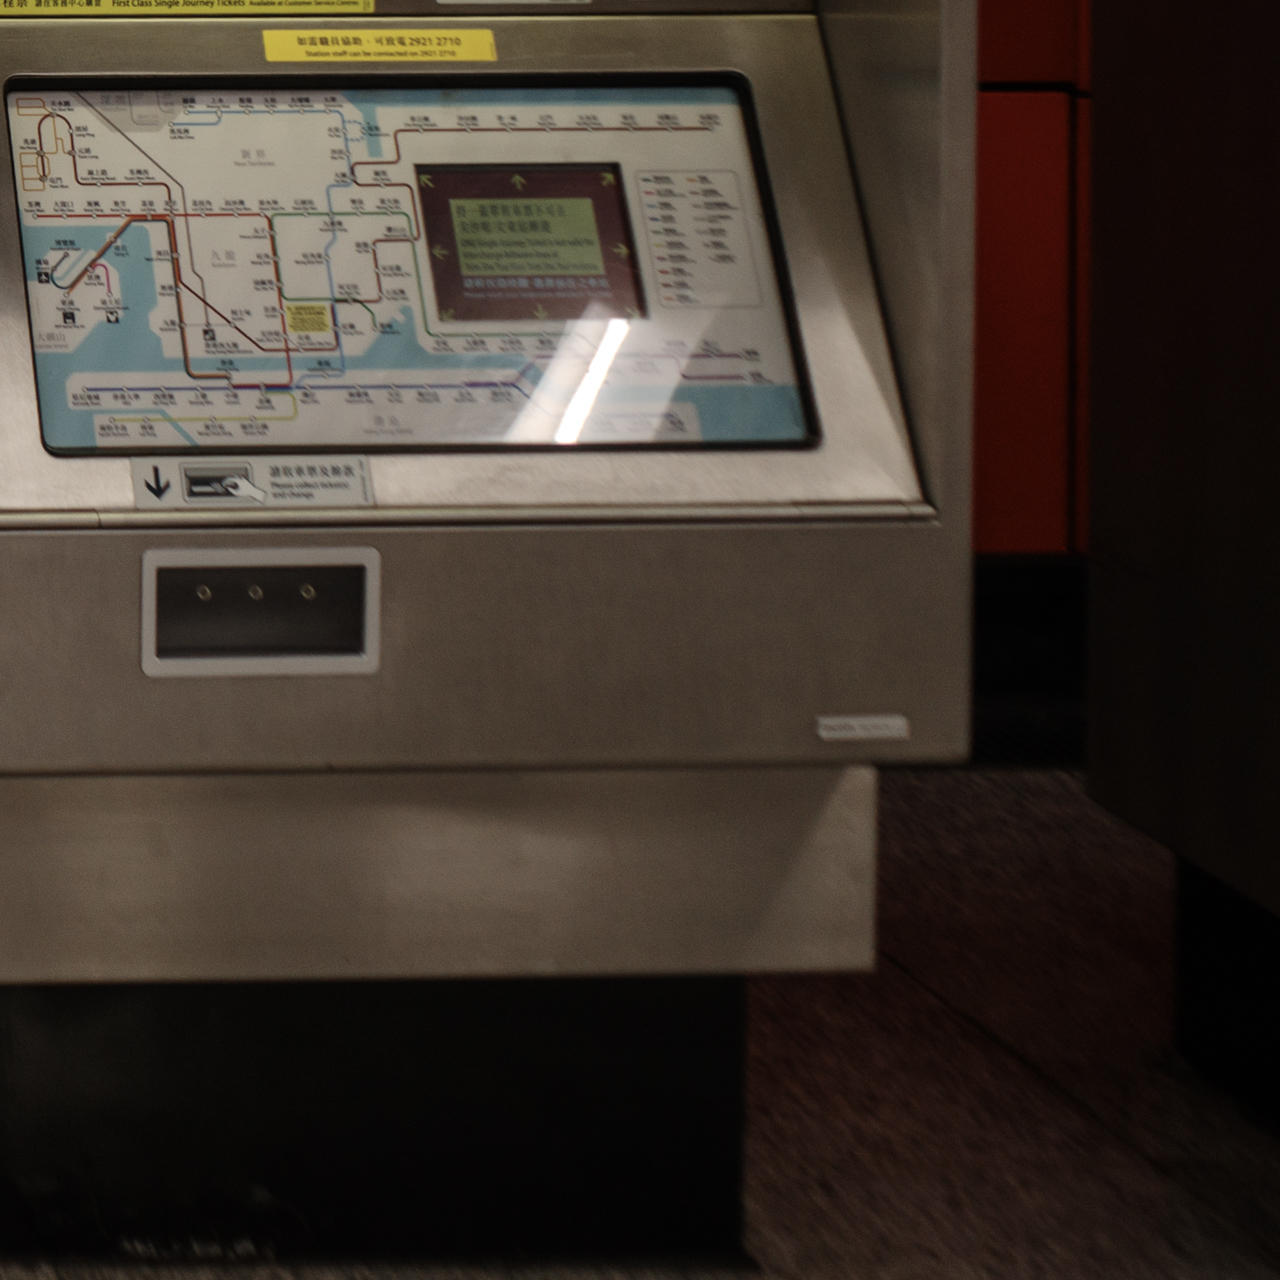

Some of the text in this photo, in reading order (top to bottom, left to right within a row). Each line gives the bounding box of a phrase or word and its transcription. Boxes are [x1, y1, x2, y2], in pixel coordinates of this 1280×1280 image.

[112, 0, 245, 9] First Class Single Journey Tickets
